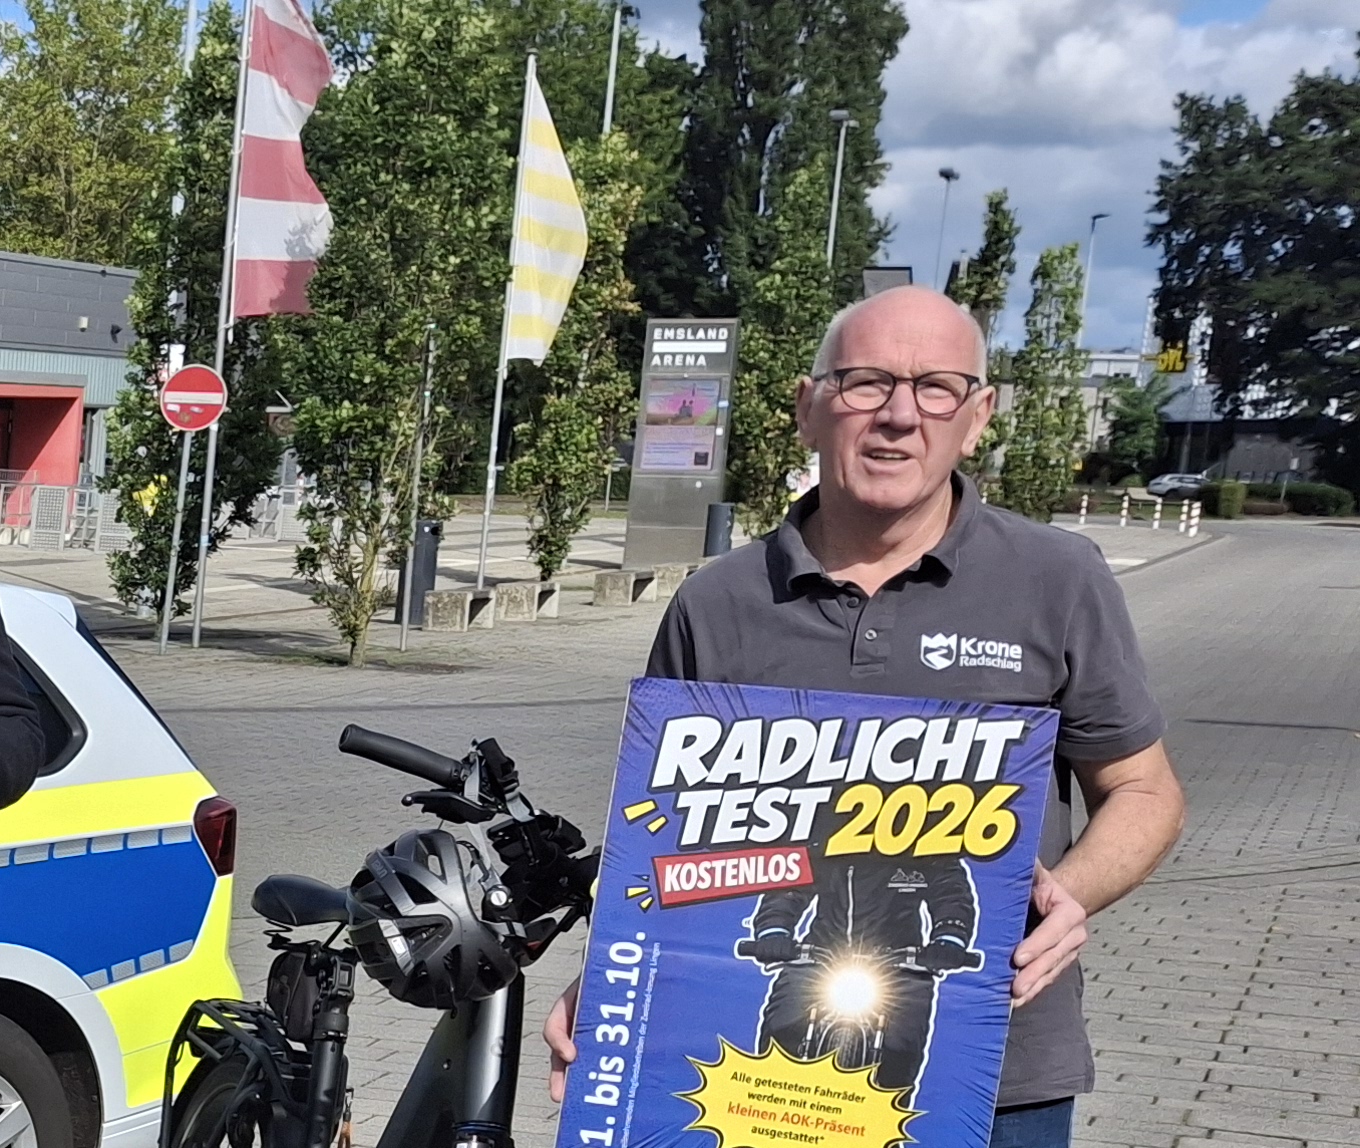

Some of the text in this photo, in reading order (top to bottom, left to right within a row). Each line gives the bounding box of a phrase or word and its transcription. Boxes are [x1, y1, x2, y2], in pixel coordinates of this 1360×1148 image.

[653, 327, 728, 340] EMSLAND
[651, 354, 707, 366] ARENA
[959, 654, 1022, 672] Radschlag
[960, 637, 1023, 659] Krone
[651, 715, 1026, 788] RADLICHT
[677, 784, 1022, 857] TEST 2026
[664, 852, 802, 893] KOSTENLOS
[595, 931, 646, 1047] 31.10.
[583, 1055, 625, 1107] bis
[730, 1071, 866, 1104] Alle getesteten Fahrräder
[727, 1101, 866, 1137] kleinen AOK-Präsent
[747, 1091, 842, 1115] werden mit einem
